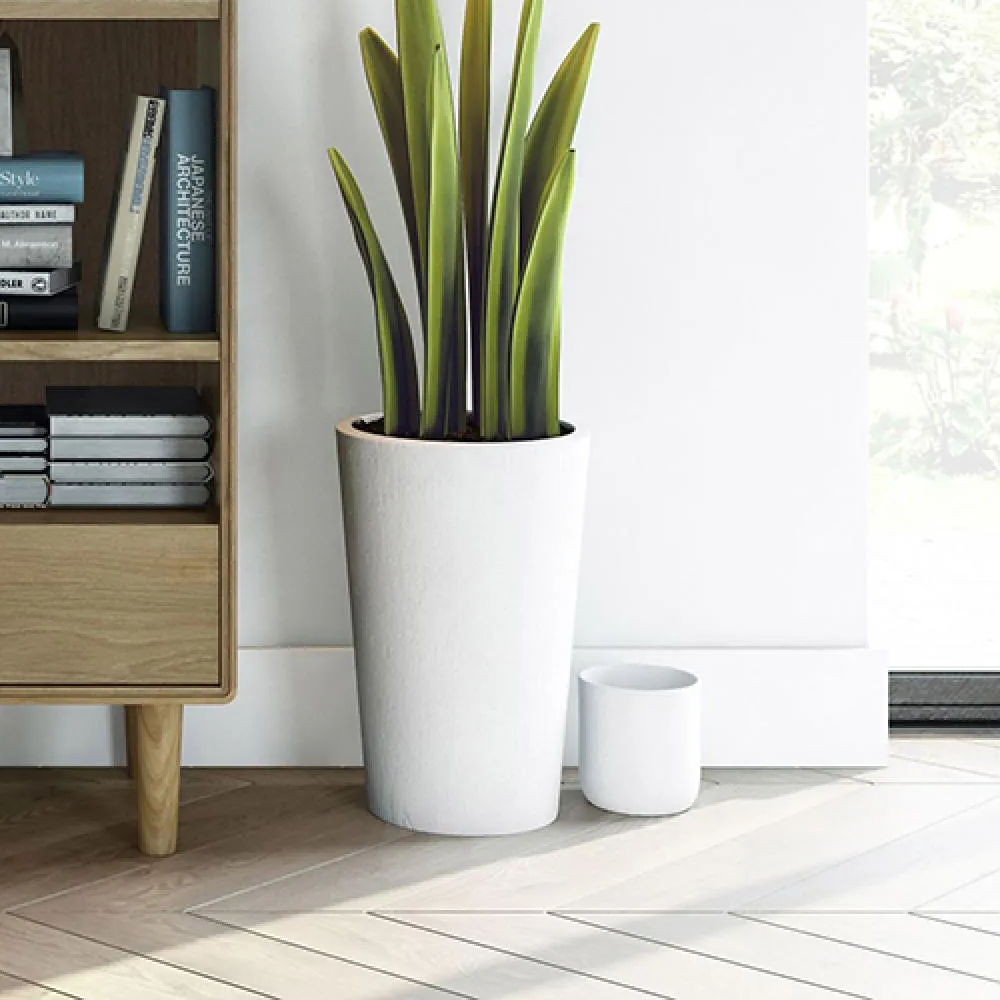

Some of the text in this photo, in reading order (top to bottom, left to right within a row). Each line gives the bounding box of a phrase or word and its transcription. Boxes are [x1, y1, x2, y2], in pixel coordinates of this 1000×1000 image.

[0, 169, 40, 189] Style
[176, 153, 191, 287] ARCHITECTURE
[191, 153, 205, 242] JAPANESE
